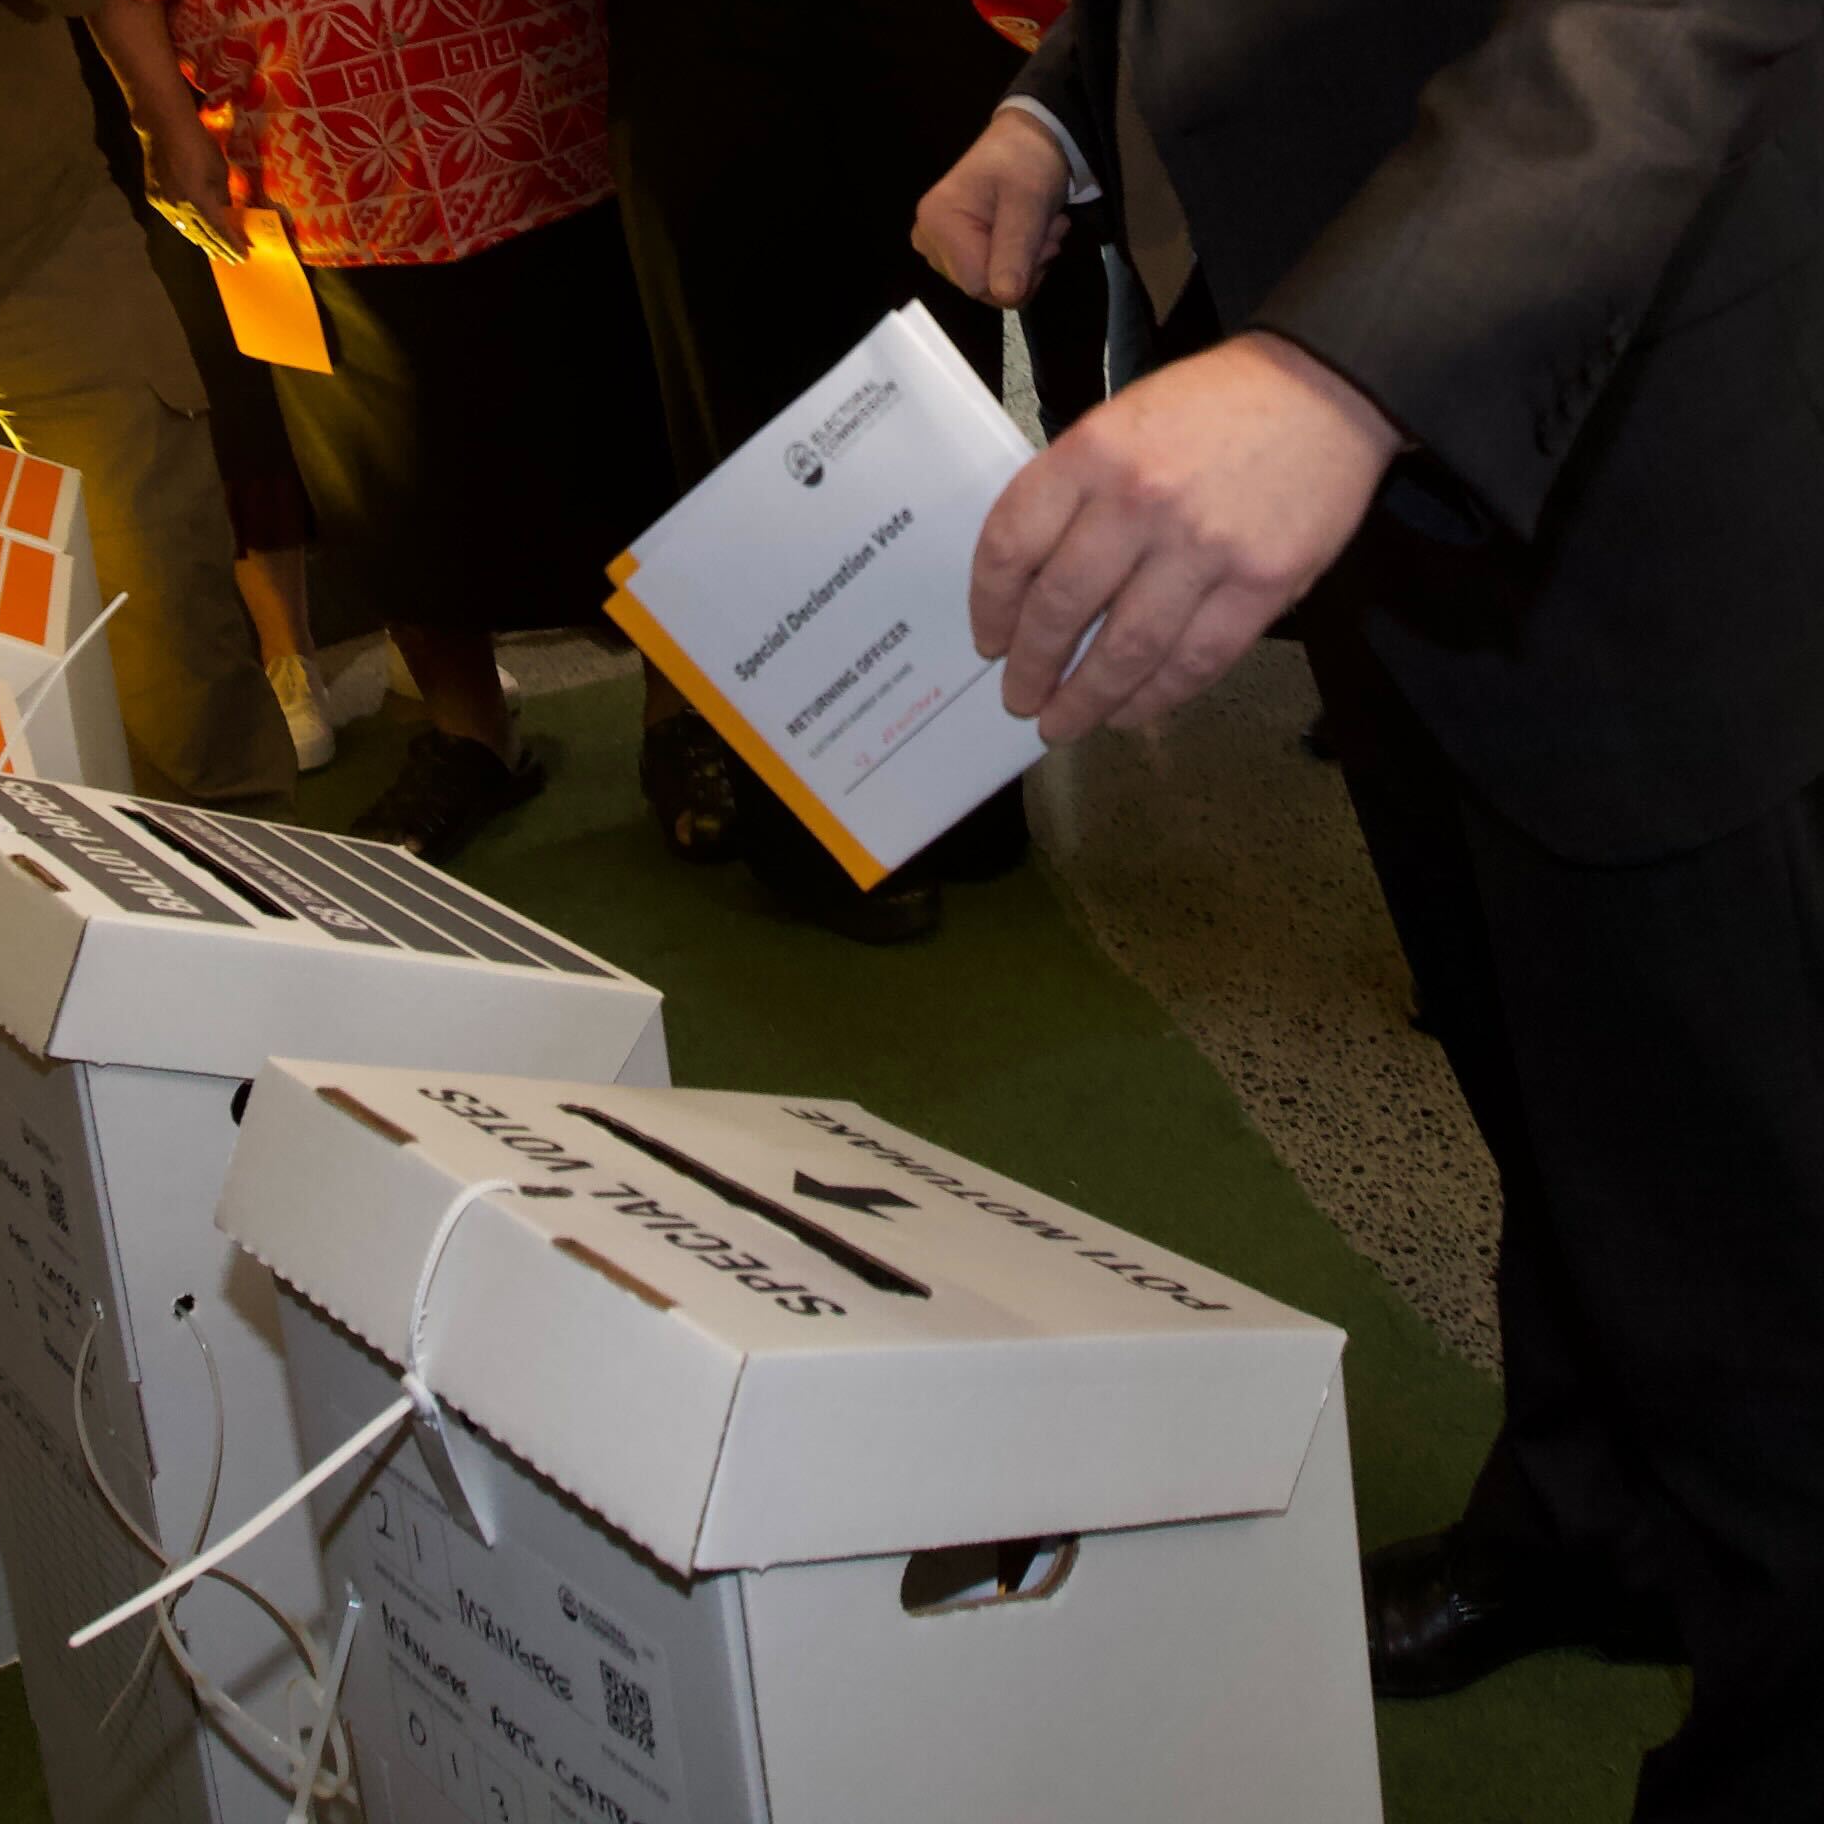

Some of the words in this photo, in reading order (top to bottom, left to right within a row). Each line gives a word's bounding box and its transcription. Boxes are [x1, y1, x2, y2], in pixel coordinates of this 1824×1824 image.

[735, 622, 789, 682] Special
[786, 543, 875, 632] Declaration
[871, 508, 913, 547] Vote
[785, 668, 858, 738] RETURNING
[855, 620, 911, 677] OFFICER
[69, 840, 204, 916] BALLOT
[418, 1087, 594, 1174] VOTES
[781, 1107, 1083, 1243] MOTUHAKE
[593, 1182, 848, 1318] SPECIAL
